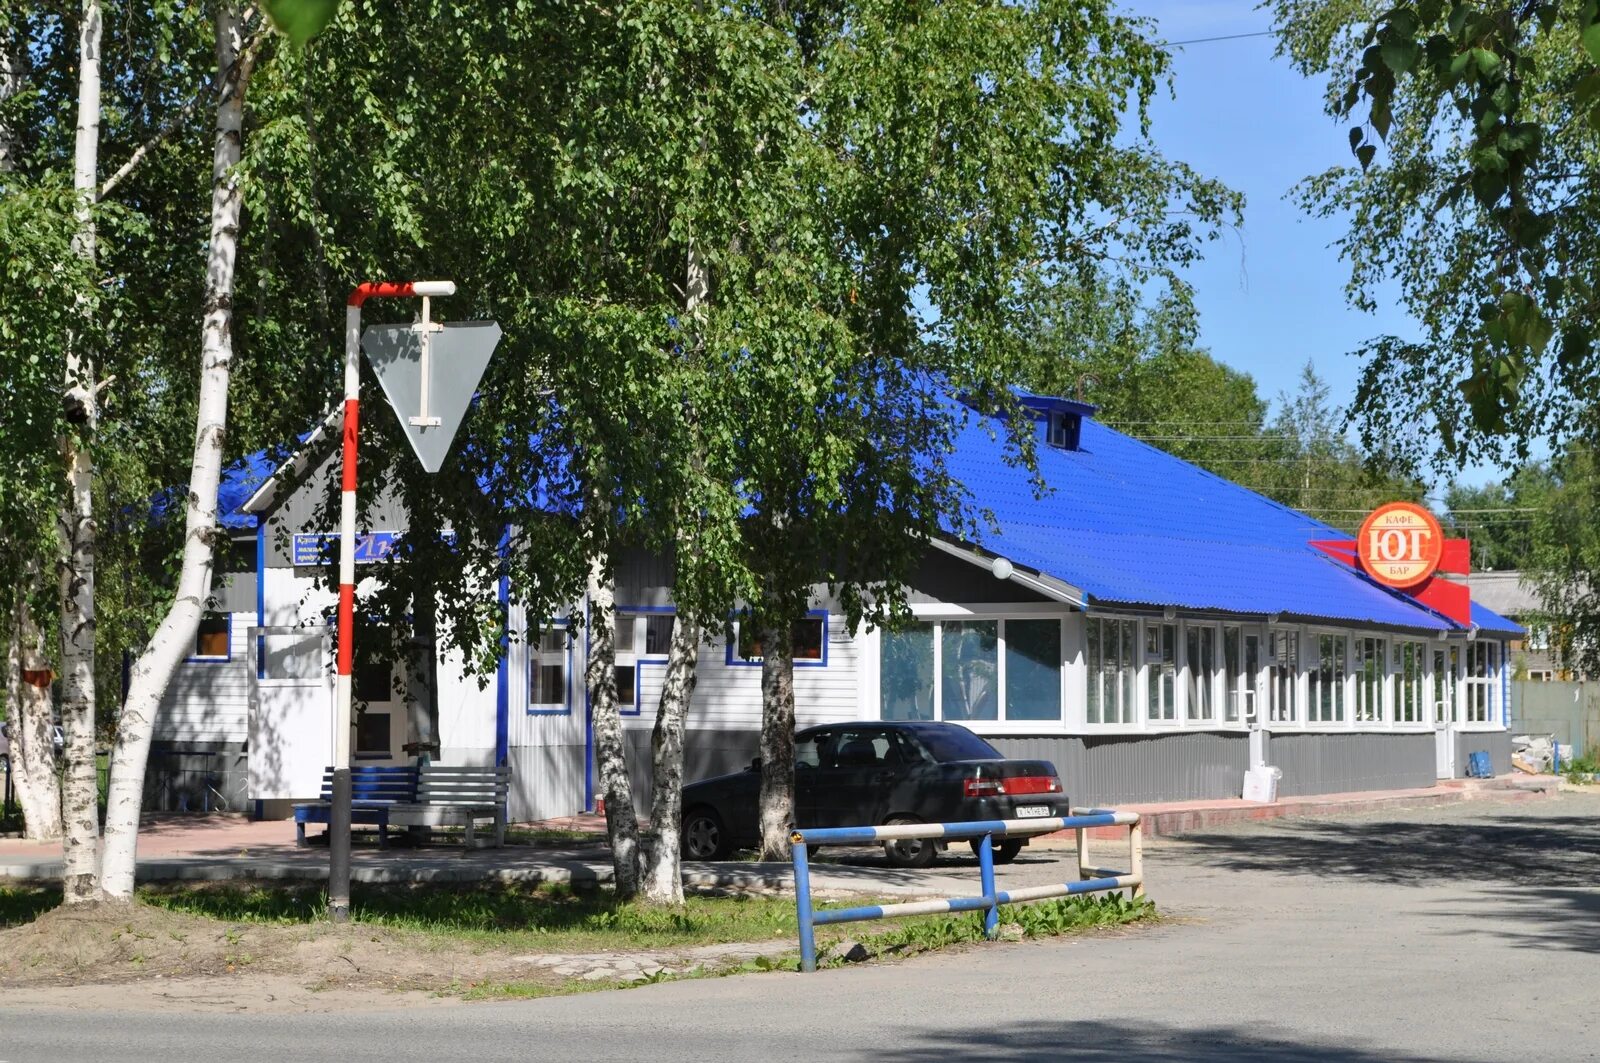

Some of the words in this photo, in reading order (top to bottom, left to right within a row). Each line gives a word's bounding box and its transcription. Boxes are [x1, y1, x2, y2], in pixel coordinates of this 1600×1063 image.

[1385, 515, 1414, 524] КАФЕ
[1368, 529, 1432, 561] ЮГ
[1389, 566, 1410, 575] БАР
